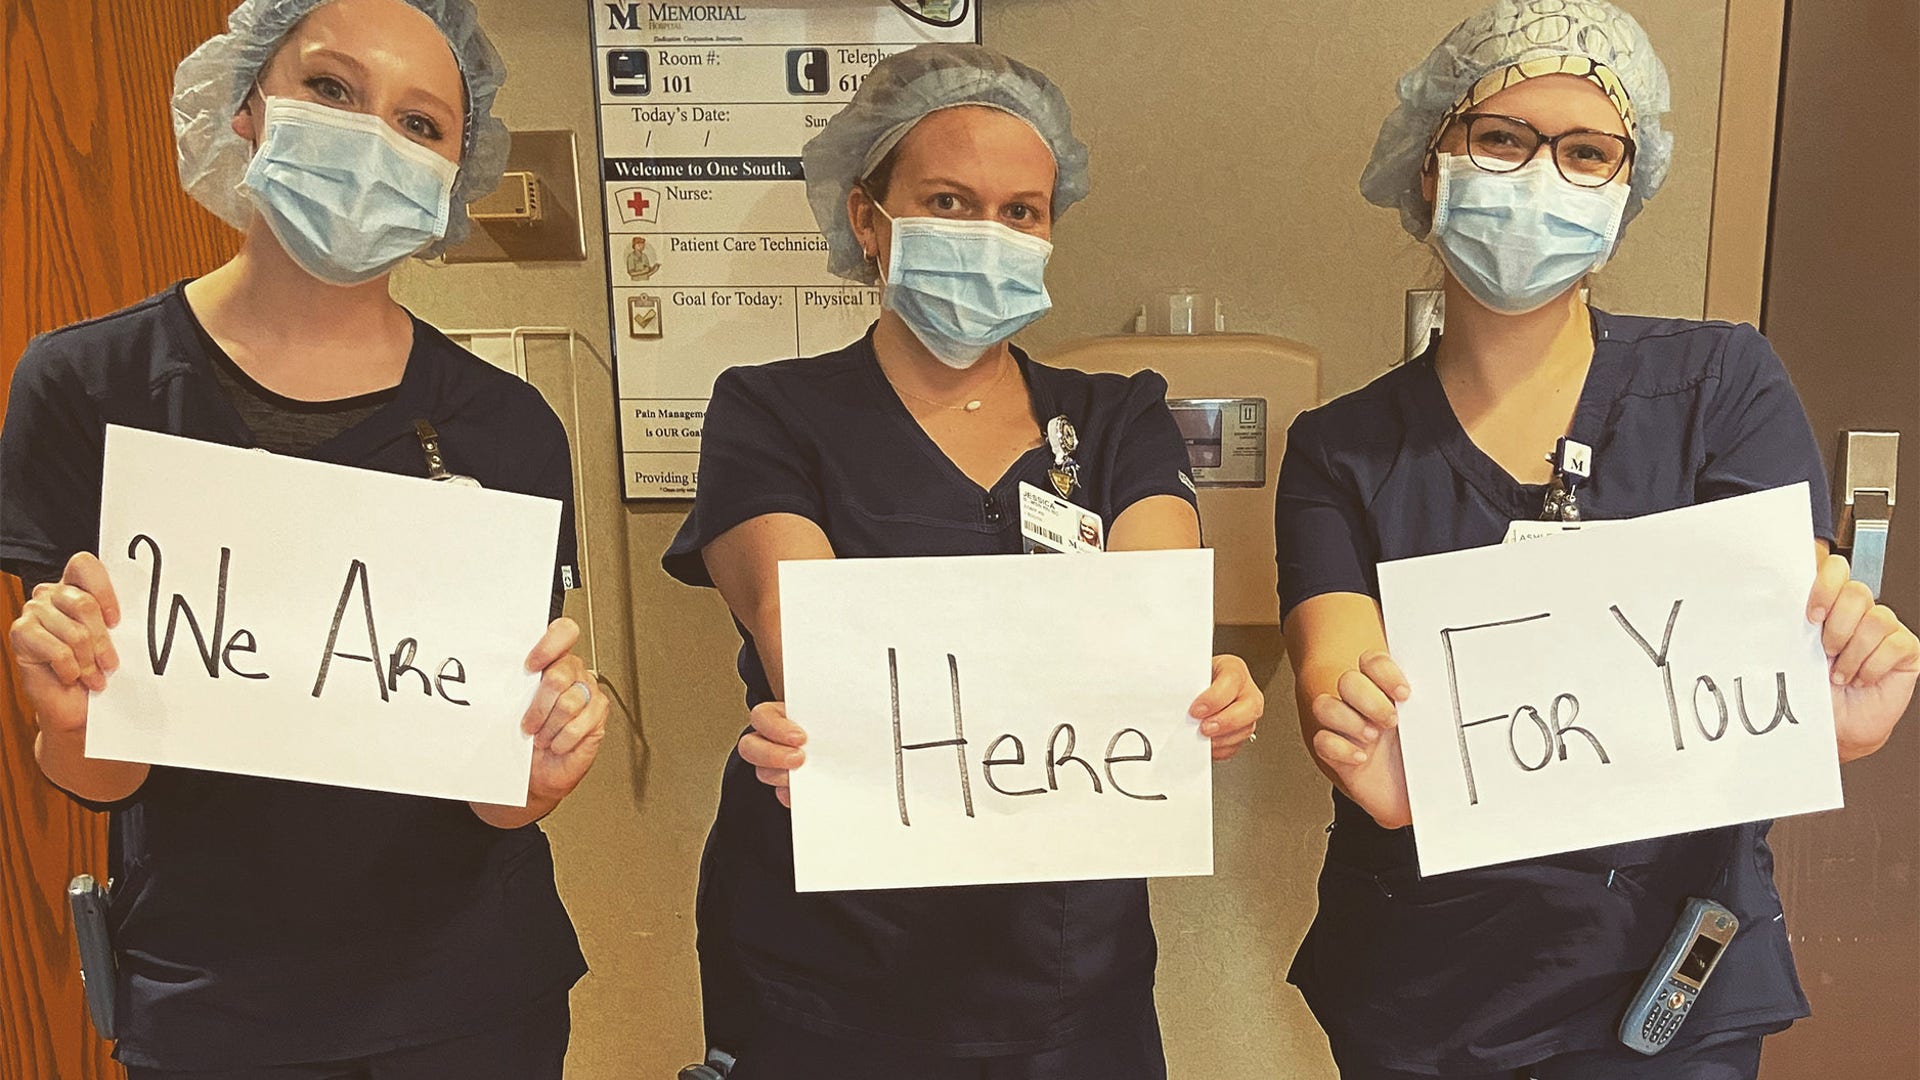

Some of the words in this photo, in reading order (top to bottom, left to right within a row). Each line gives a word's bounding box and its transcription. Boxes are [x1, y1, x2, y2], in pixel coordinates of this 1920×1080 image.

[605, 3, 642, 30] M
[648, 3, 746, 21] MEMORIAL
[659, 51, 702, 66] Room
[706, 51, 721, 66] #:
[662, 76, 692, 93] 101
[631, 107, 688, 125] Today's
[693, 107, 730, 122] Date:
[614, 162, 683, 176] Welcome
[688, 162, 702, 176] to
[707, 161, 738, 176] One
[743, 161, 791, 176] South.
[666, 186, 712, 201] Nurse:
[671, 237, 719, 252] Patient
[723, 237, 756, 252] Care
[760, 236, 829, 252] Technicia
[673, 291, 706, 306] Goal
[711, 291, 732, 306] for
[734, 291, 783, 310] Today:
[804, 290, 863, 310] Physical
[635, 409, 656, 419] Pain
[655, 428, 680, 437] OUR
[1570, 458, 1584, 472] M
[635, 471, 689, 487] Providing
[128, 533, 270, 680] We
